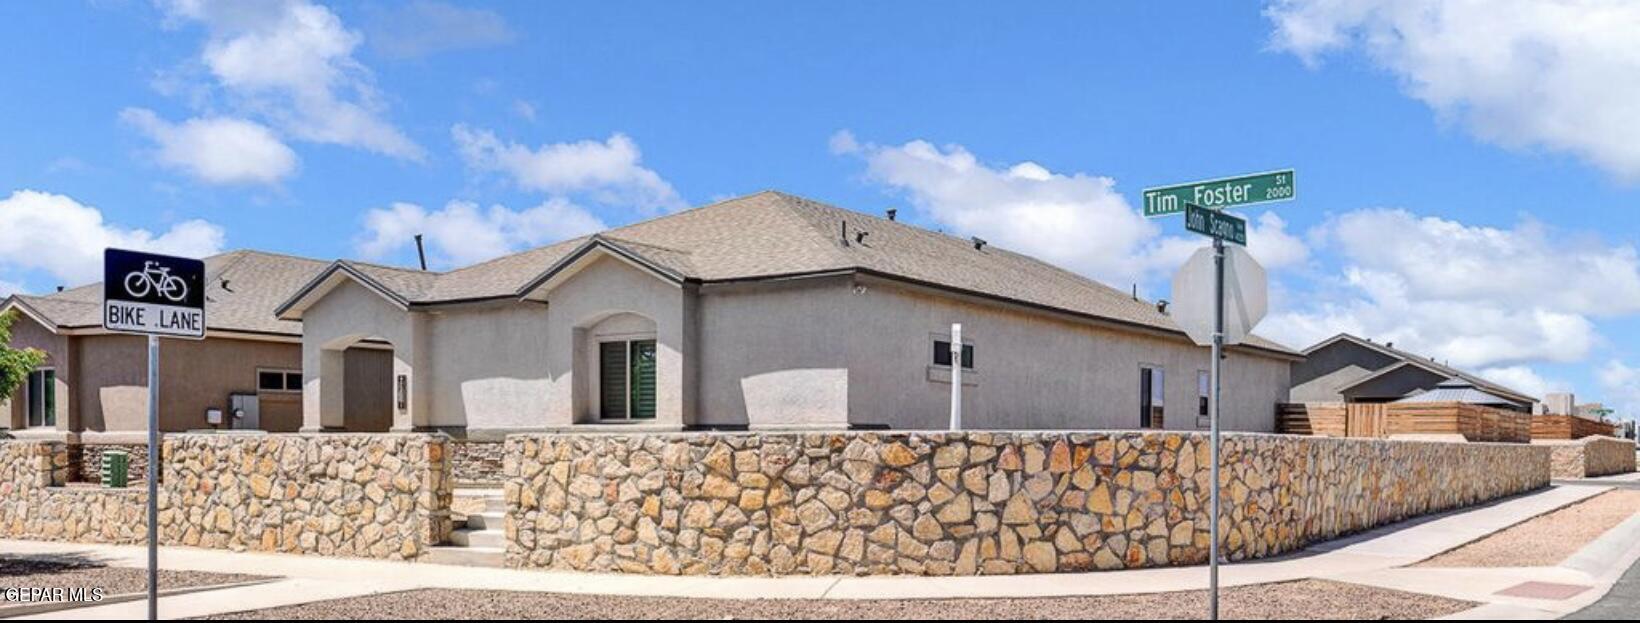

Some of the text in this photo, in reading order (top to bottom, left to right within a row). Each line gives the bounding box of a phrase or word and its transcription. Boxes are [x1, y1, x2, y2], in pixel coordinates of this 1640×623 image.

[1146, 183, 1252, 213] Tim Foster
[1266, 186, 1291, 199] 2000
[109, 305, 201, 331] BIKE LANE
